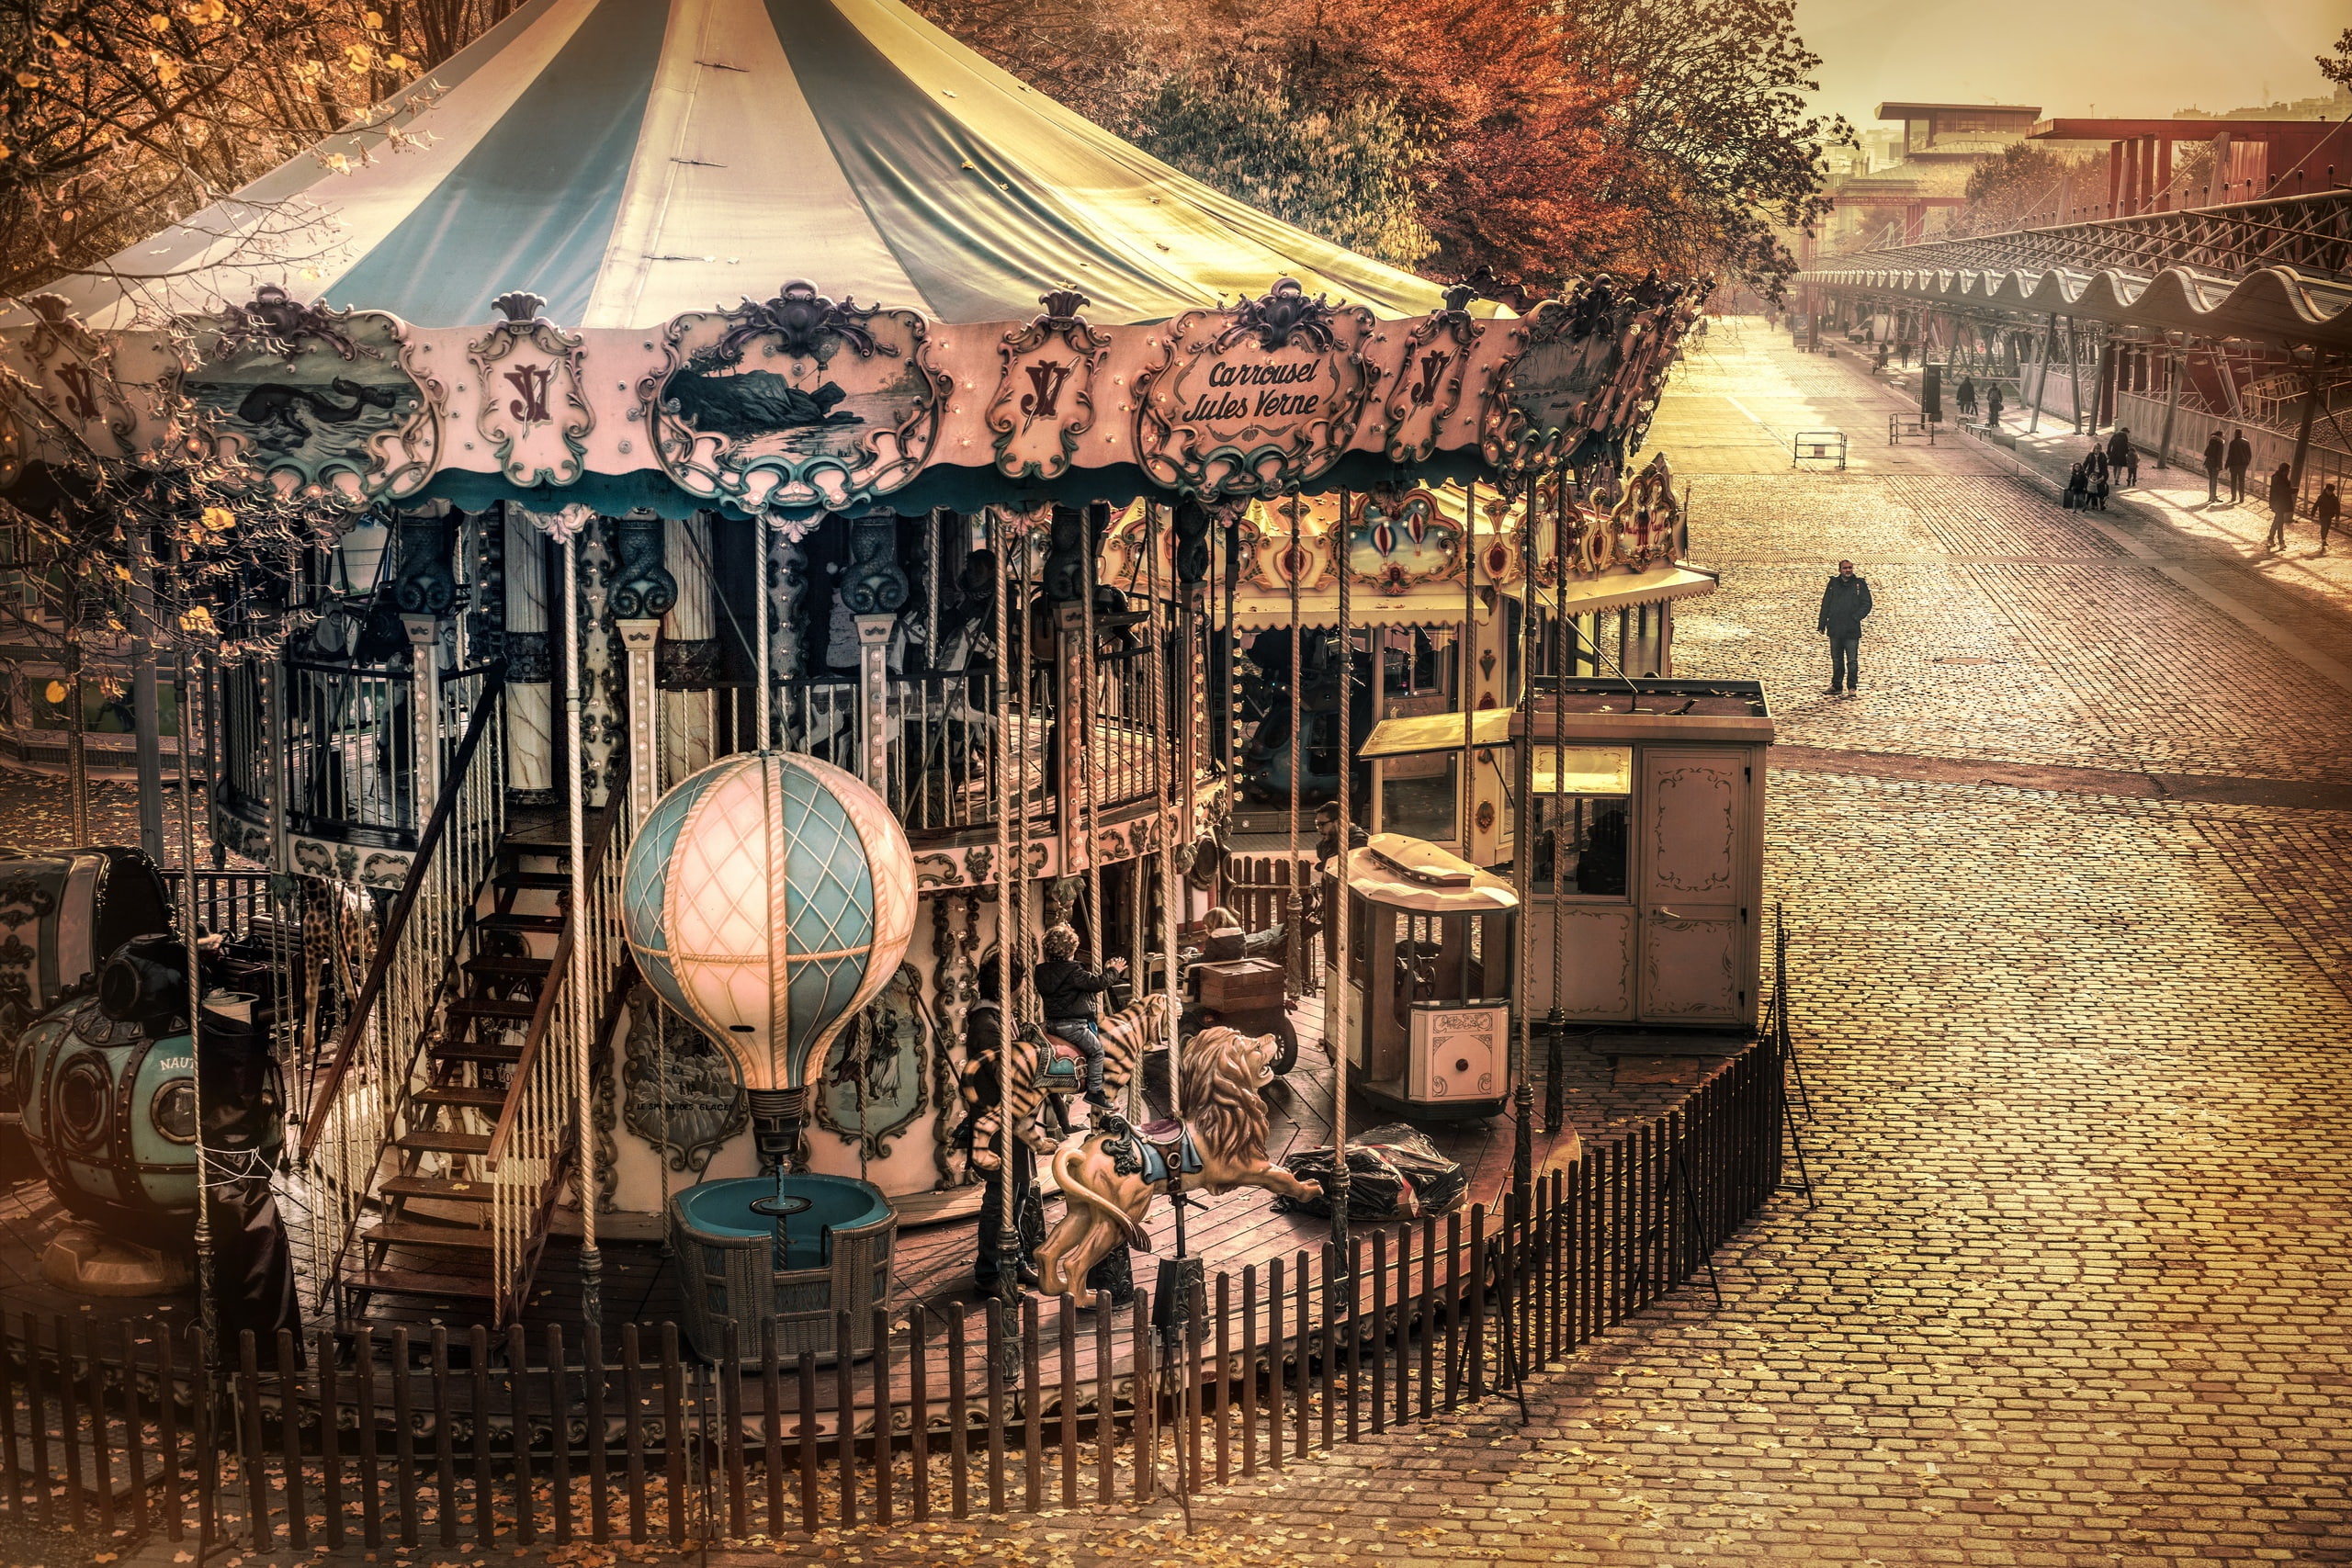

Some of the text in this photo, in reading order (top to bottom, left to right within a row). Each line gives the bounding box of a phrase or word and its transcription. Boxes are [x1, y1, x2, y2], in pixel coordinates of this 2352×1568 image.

[1209, 359, 1321, 388] Carrousel
[1182, 389, 1319, 422] Jules Verne
